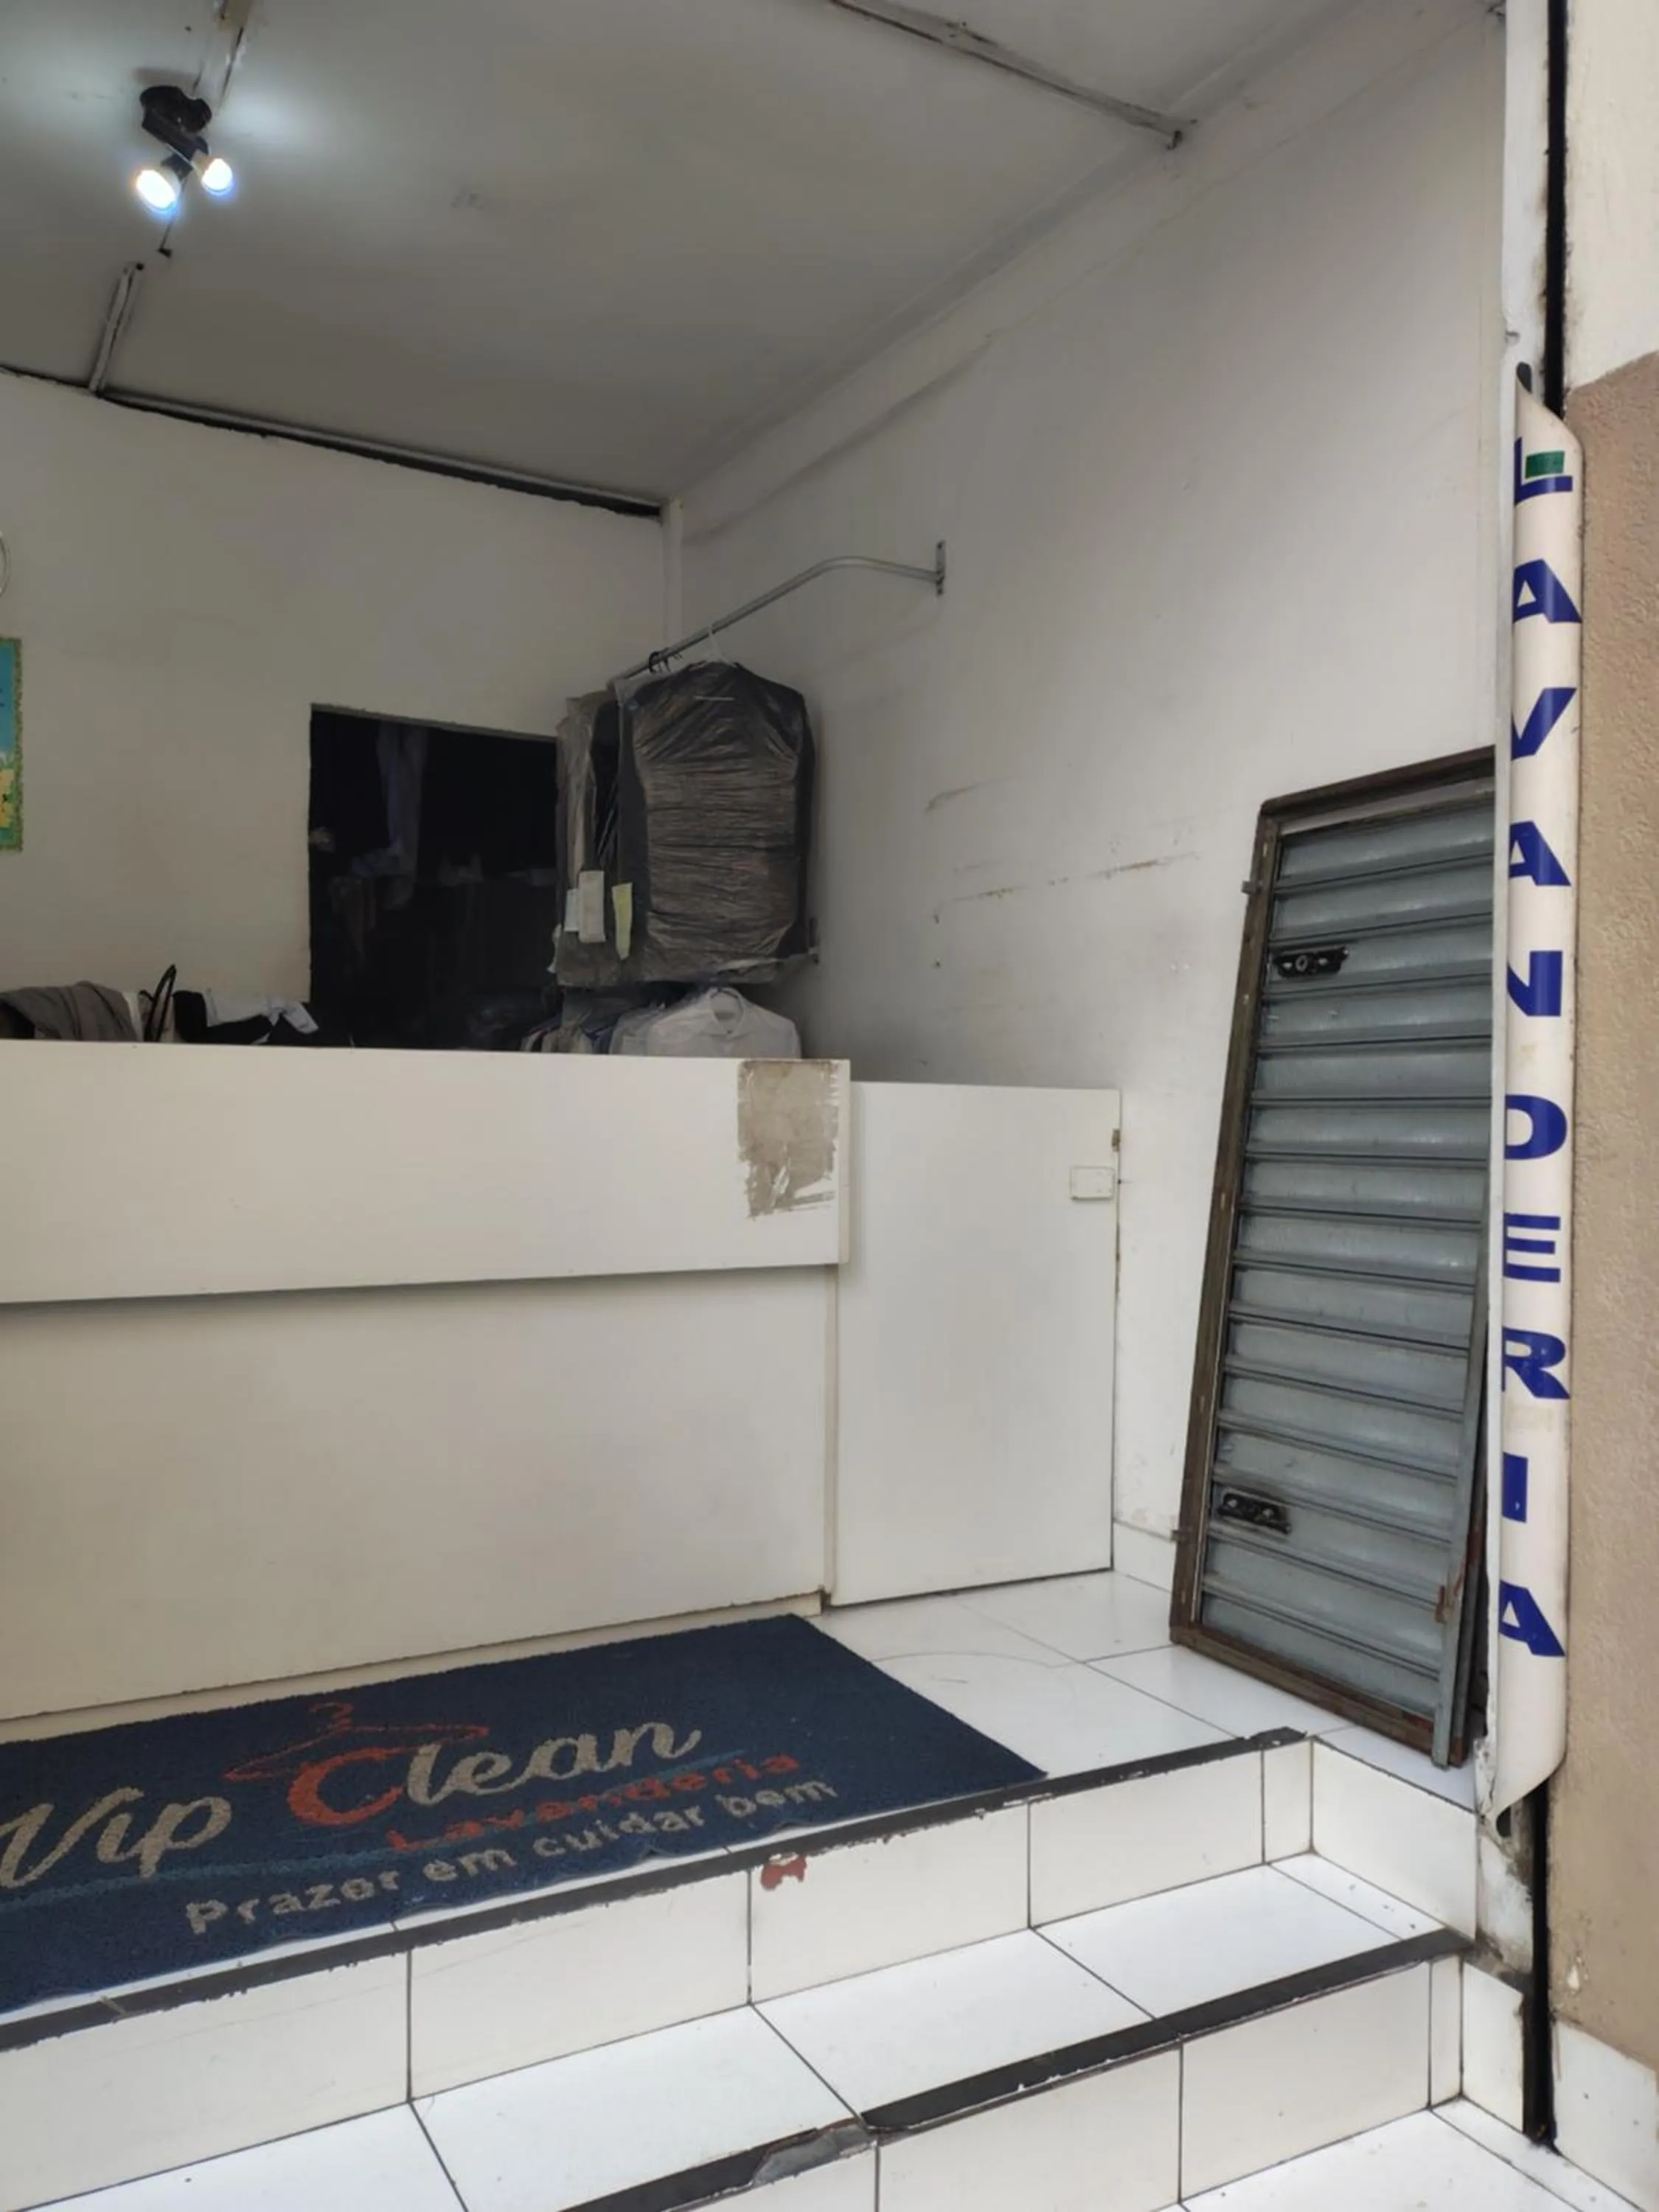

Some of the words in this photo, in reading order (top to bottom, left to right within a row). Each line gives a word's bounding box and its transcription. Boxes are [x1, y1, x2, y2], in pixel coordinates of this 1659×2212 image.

[0, 1787, 232, 1888] Vip
[287, 1722, 701, 1826] Clean
[186, 1871, 400, 1935] Prazer
[423, 1849, 516, 1882] em
[533, 1804, 705, 1857] cuidar
[715, 1781, 838, 1818] bem
